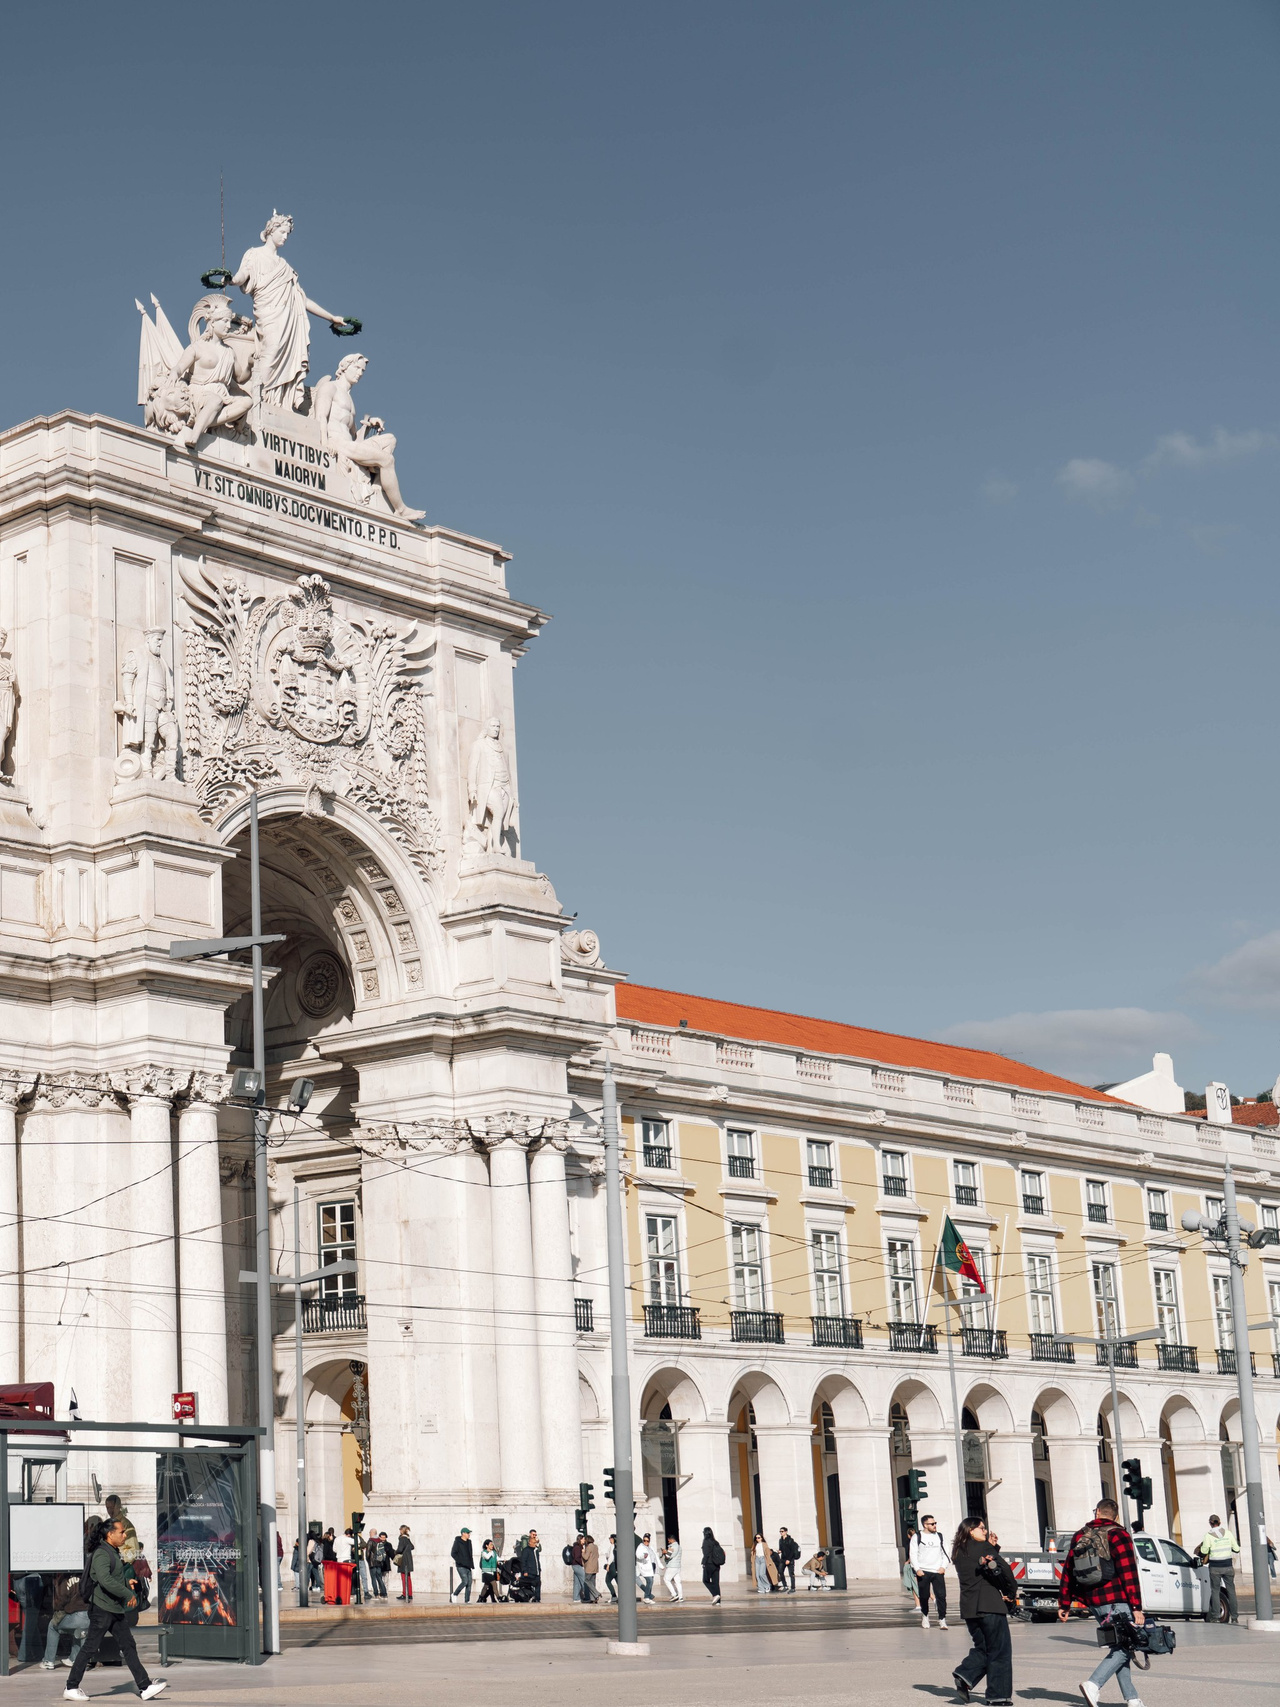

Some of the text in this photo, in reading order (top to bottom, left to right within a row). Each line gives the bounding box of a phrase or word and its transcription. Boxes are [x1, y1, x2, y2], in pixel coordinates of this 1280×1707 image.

[261, 430, 330, 469] VIRTVTIBVS
[215, 476, 235, 498] SIT.
[274, 458, 326, 491] MAIORVM
